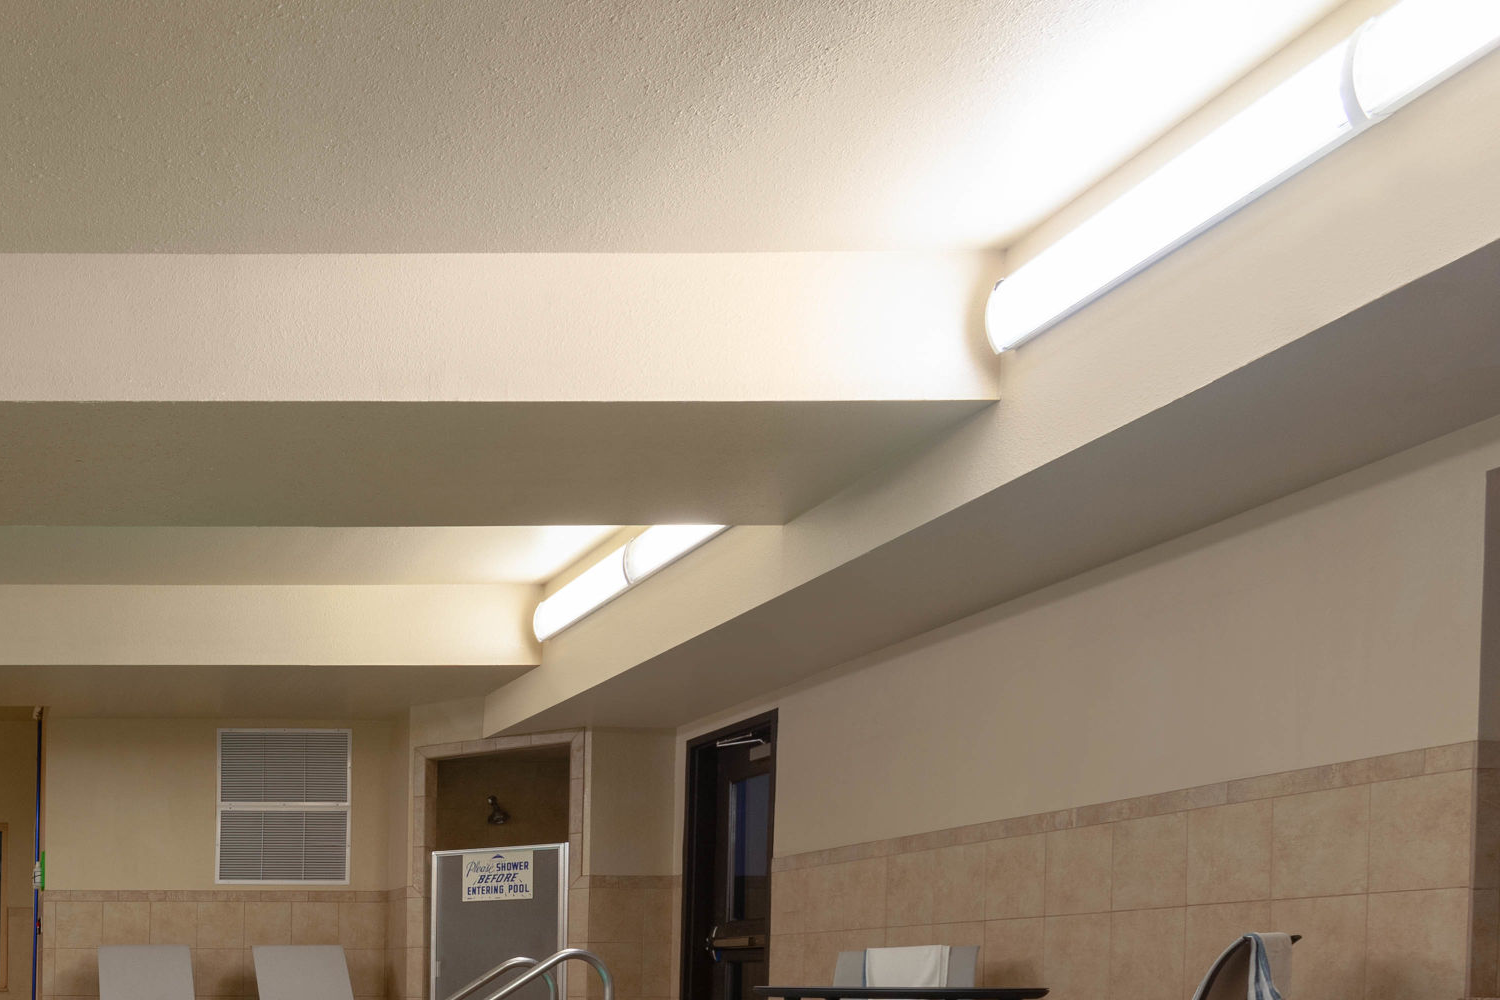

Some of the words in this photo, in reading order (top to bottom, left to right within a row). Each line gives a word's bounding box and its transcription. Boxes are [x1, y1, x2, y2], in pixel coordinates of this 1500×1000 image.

[496, 861, 529, 871] SHOWER
[477, 873, 519, 884] BEFORE
[467, 885, 504, 895] ENTERING
[508, 884, 529, 893] POOL
